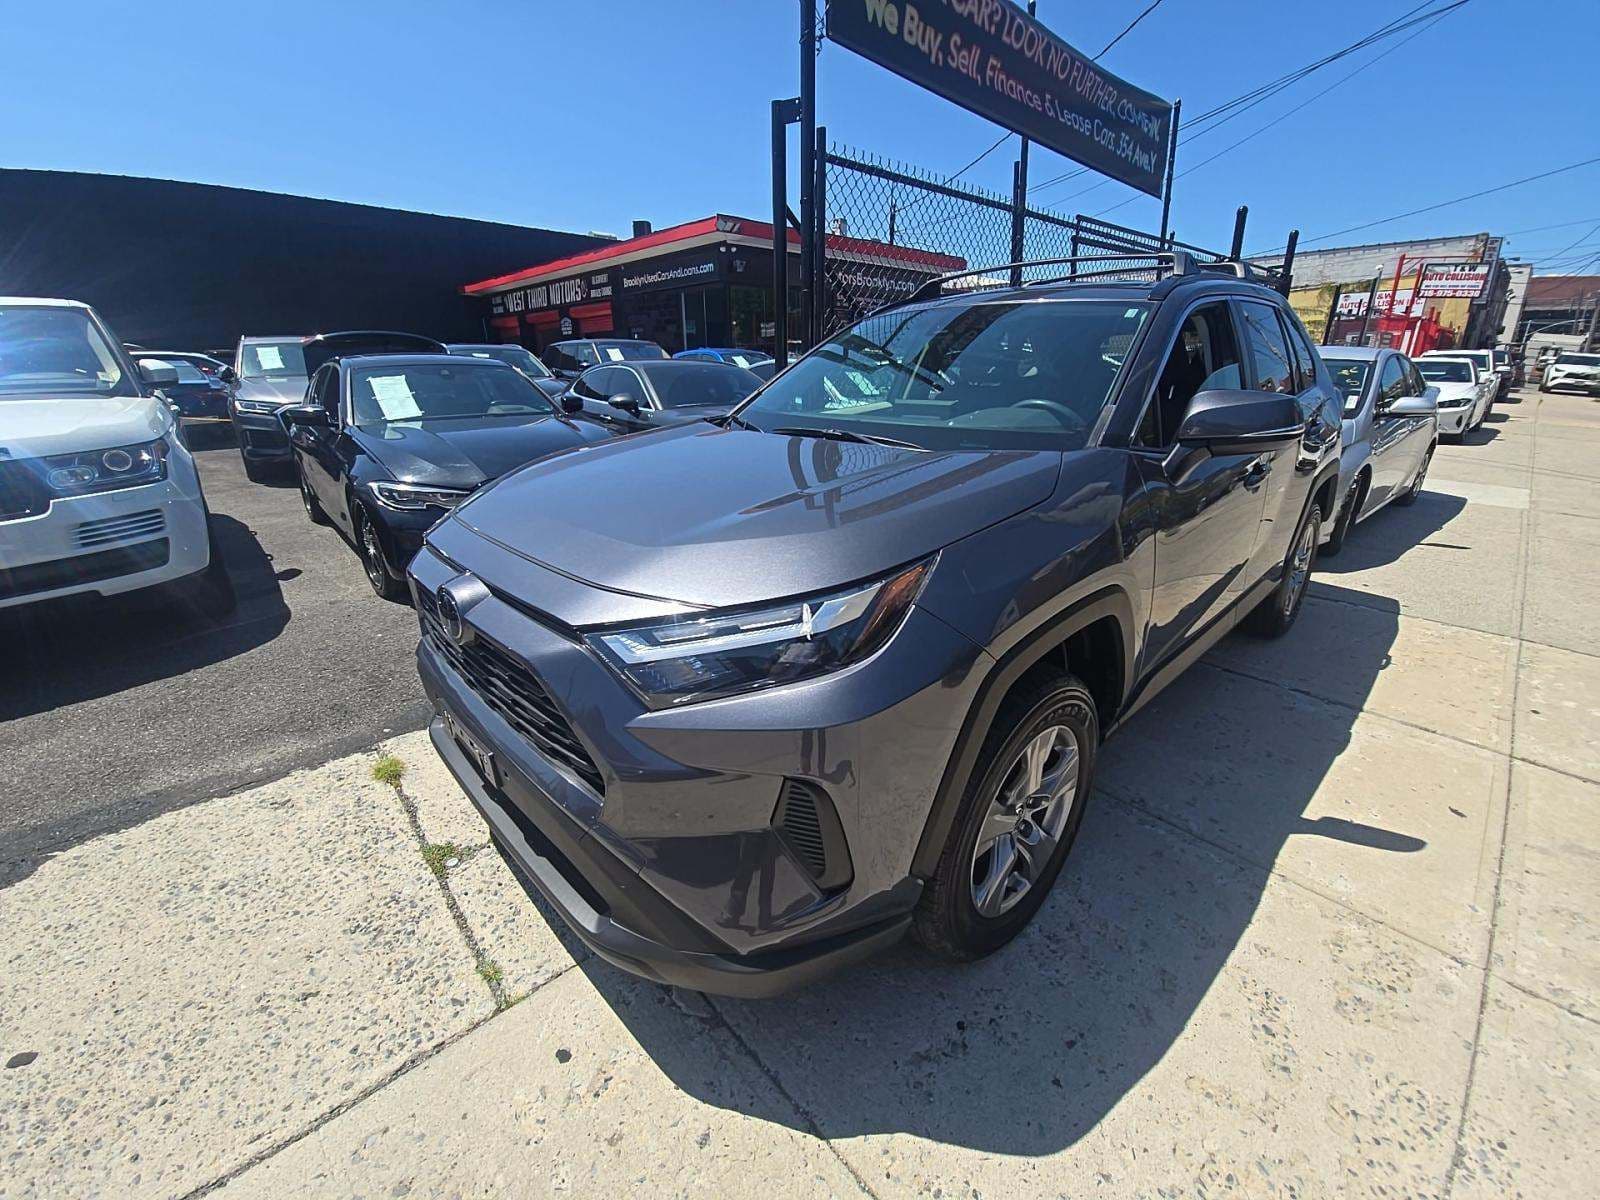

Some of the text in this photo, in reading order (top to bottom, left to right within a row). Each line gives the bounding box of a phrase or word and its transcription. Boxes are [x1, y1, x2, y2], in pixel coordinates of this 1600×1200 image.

[865, 0, 899, 35] We
[903, 3, 943, 67] Buy,
[947, 31, 981, 87] Sell,
[985, 53, 1042, 112] Finance
[1044, 93, 1056, 119] &
[1055, 99, 1092, 136] Lease
[1002, 5, 1048, 67] LOOK
[1046, 44, 1071, 80] NO
[1069, 60, 1117, 117] FURTHER,
[1423, 272, 1488, 281] AUTO COLLISION
[507, 290, 527, 313] WEST
[527, 285, 548, 310] THIRD
[549, 278, 582, 306] MOTORS
[1339, 301, 1360, 309] AUTO
[1362, 299, 1405, 308] CLISON
